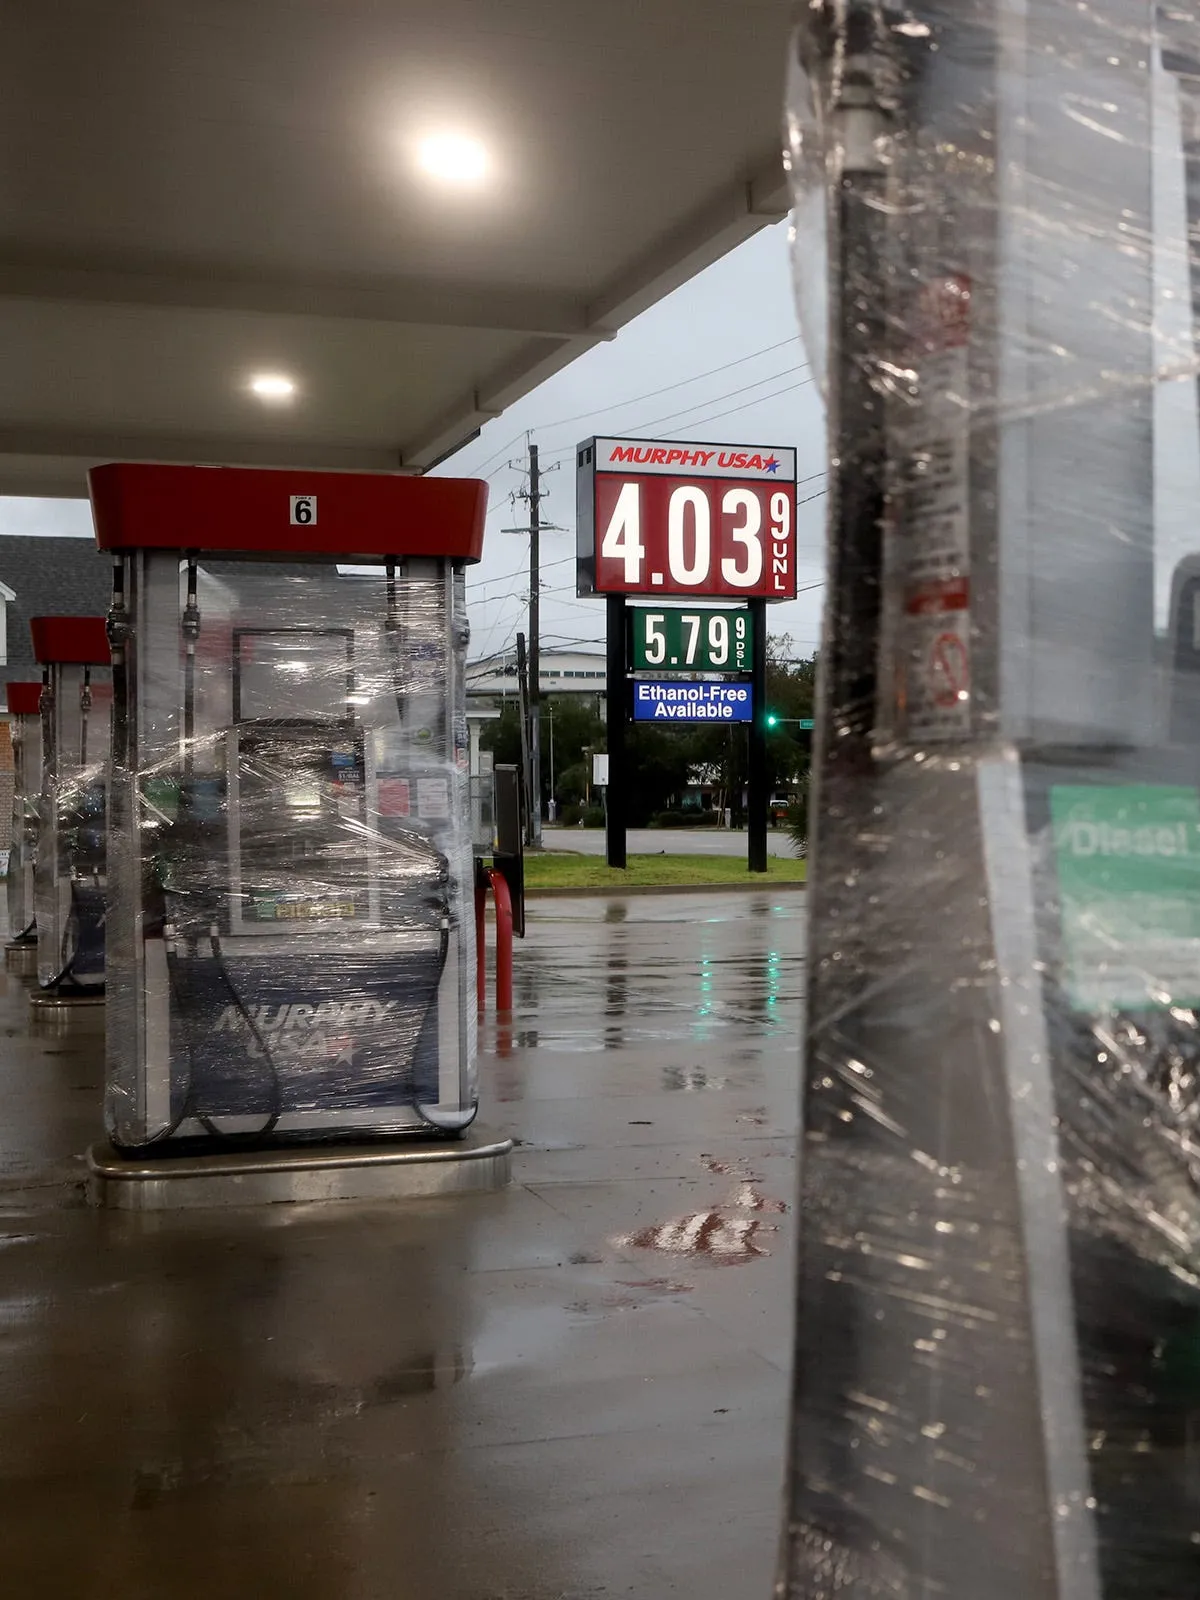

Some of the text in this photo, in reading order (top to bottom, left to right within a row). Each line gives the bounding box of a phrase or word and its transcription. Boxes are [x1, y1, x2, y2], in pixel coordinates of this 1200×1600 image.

[609, 446, 763, 470] MURPHY USA
[295, 500, 311, 524] 6
[602, 482, 762, 587] 4.03
[772, 543, 788, 590] UNL
[645, 614, 729, 665] 5.79
[736, 641, 745, 668] DSL
[638, 685, 748, 701] Ethanol-Free
[654, 702, 733, 718] Available
[1070, 821, 1189, 857] Diesel
